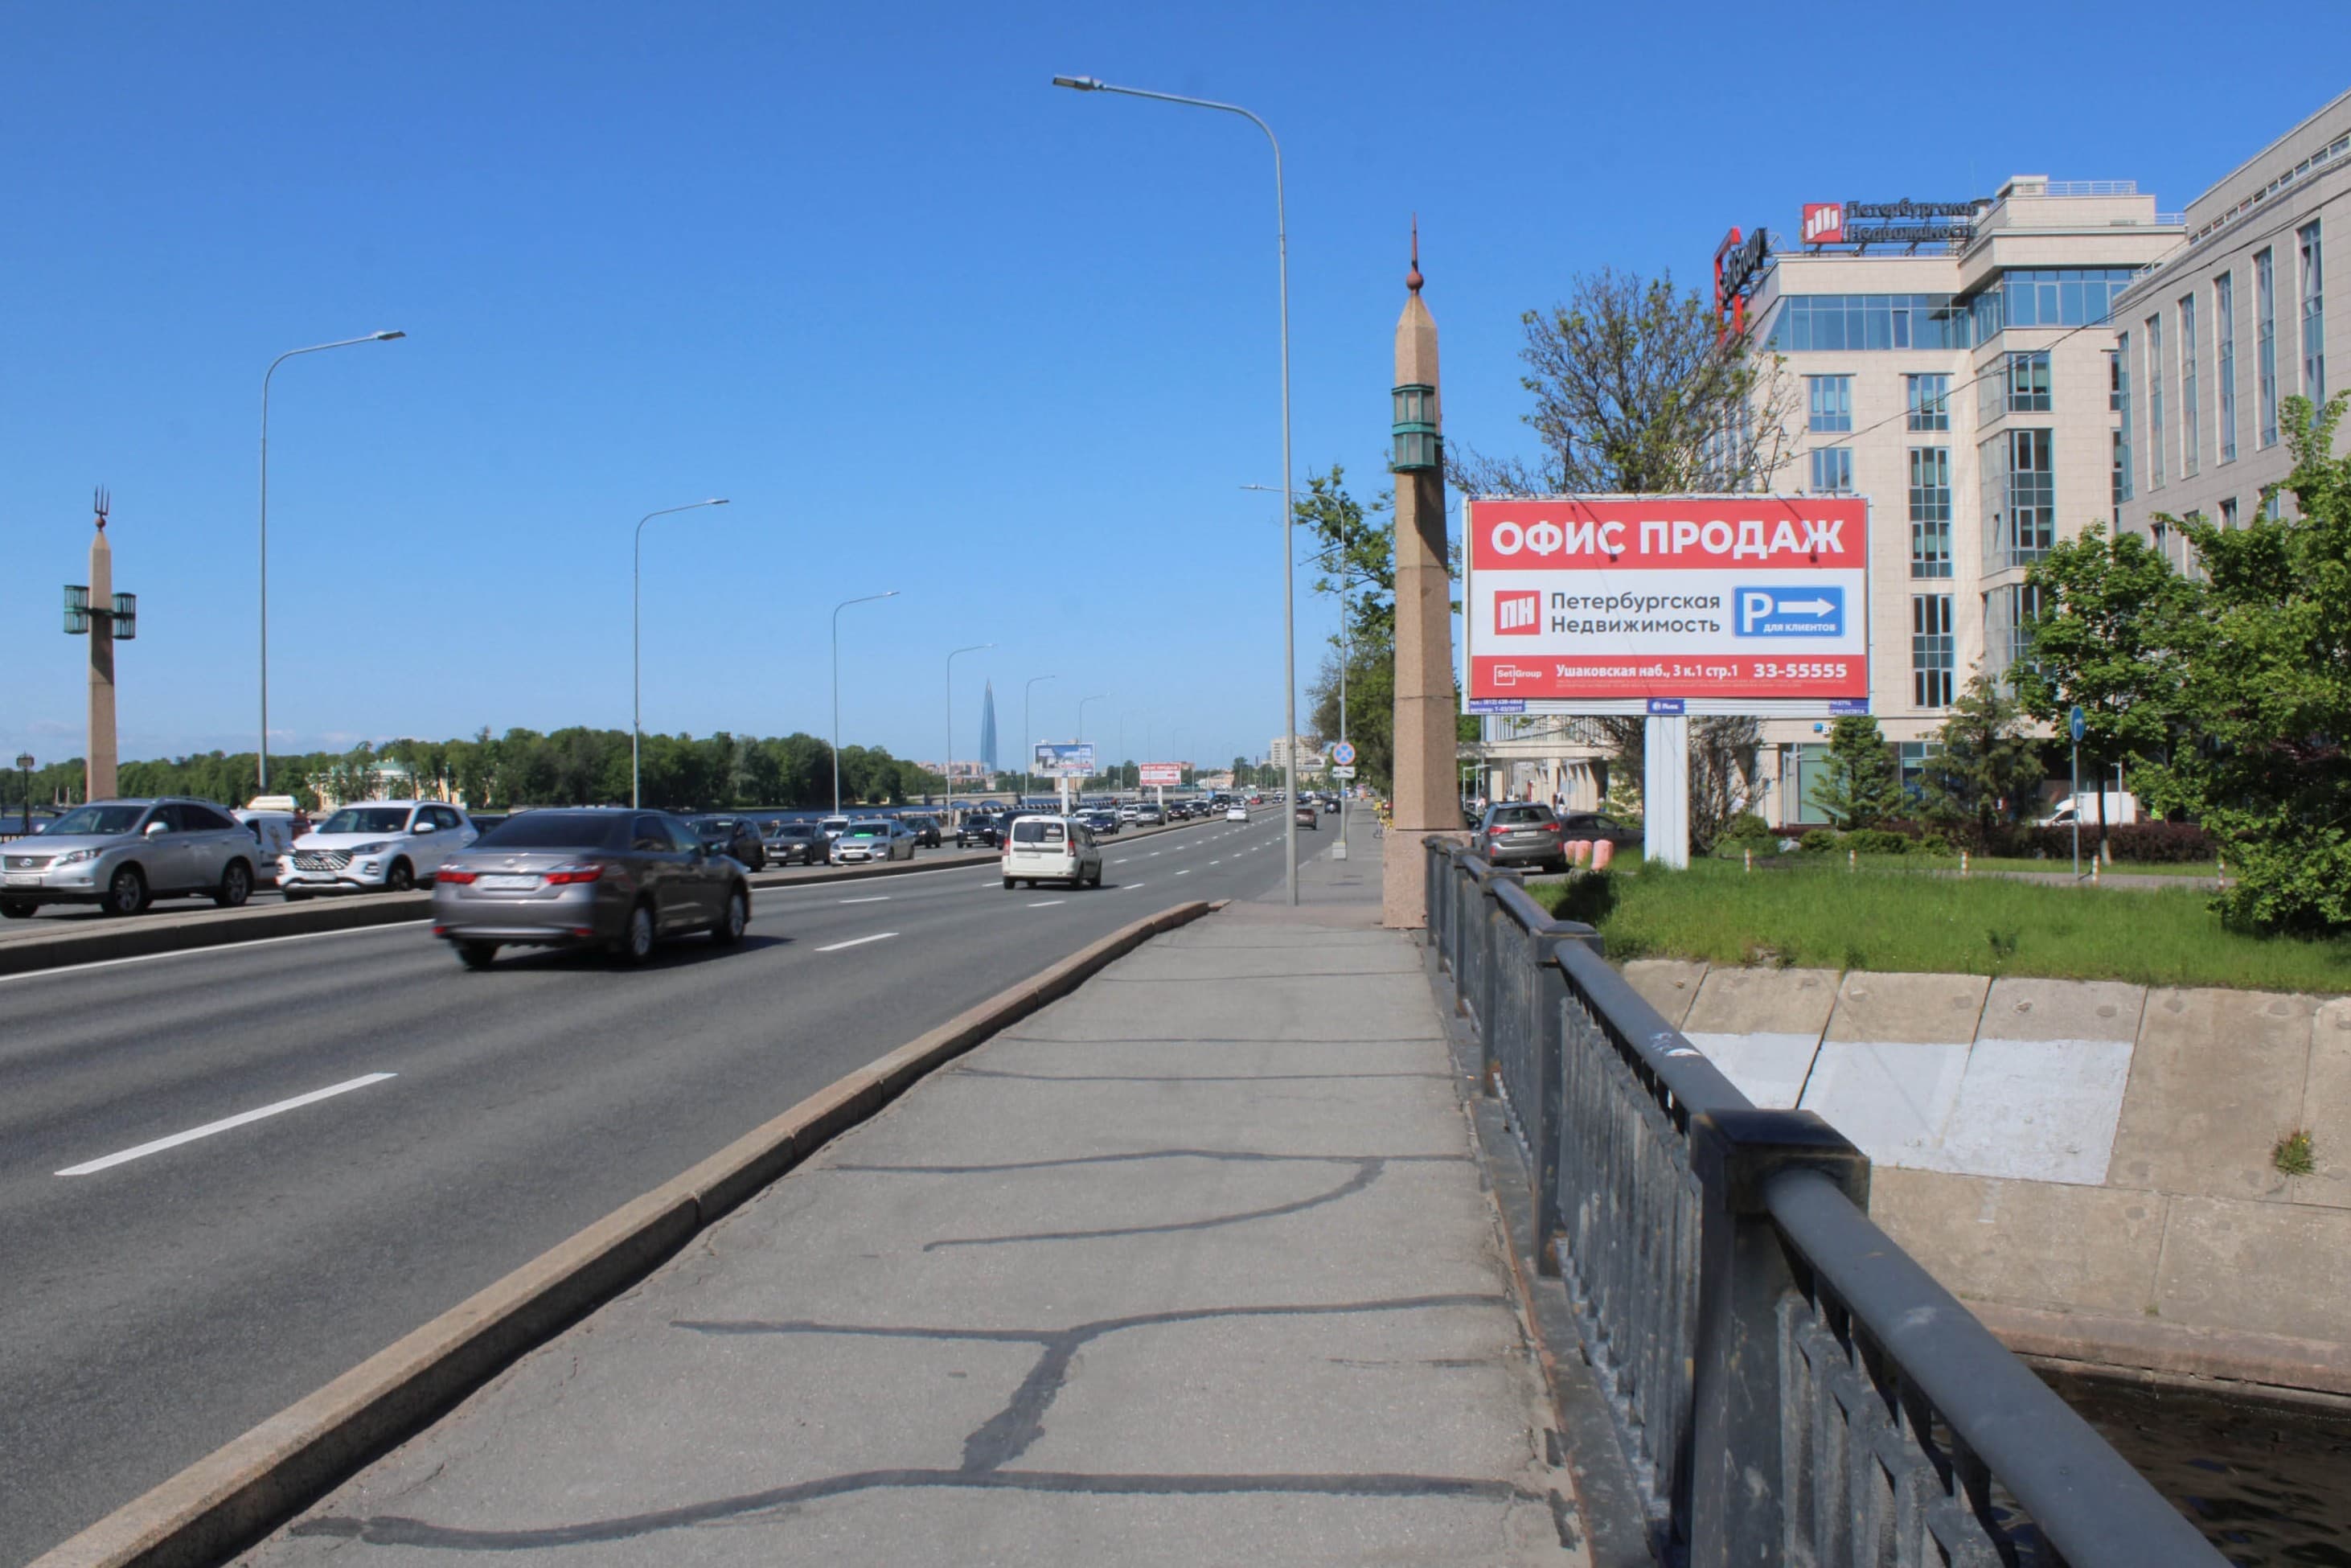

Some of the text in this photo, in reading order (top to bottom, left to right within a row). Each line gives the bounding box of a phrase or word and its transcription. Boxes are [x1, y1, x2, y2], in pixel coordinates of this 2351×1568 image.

[1491, 520, 1844, 559] ОФИС ПРОДАЖ
[1551, 592, 1721, 613] Петербургская
[1551, 616, 1721, 633] Недвижимость
[1763, 623, 1836, 633] ДЛЯ КЛИЕНТОВ
[1556, 664, 1738, 679] Ушаковская наб., 3 к.1 стр.1
[1754, 663, 1847, 678] 33-55555
